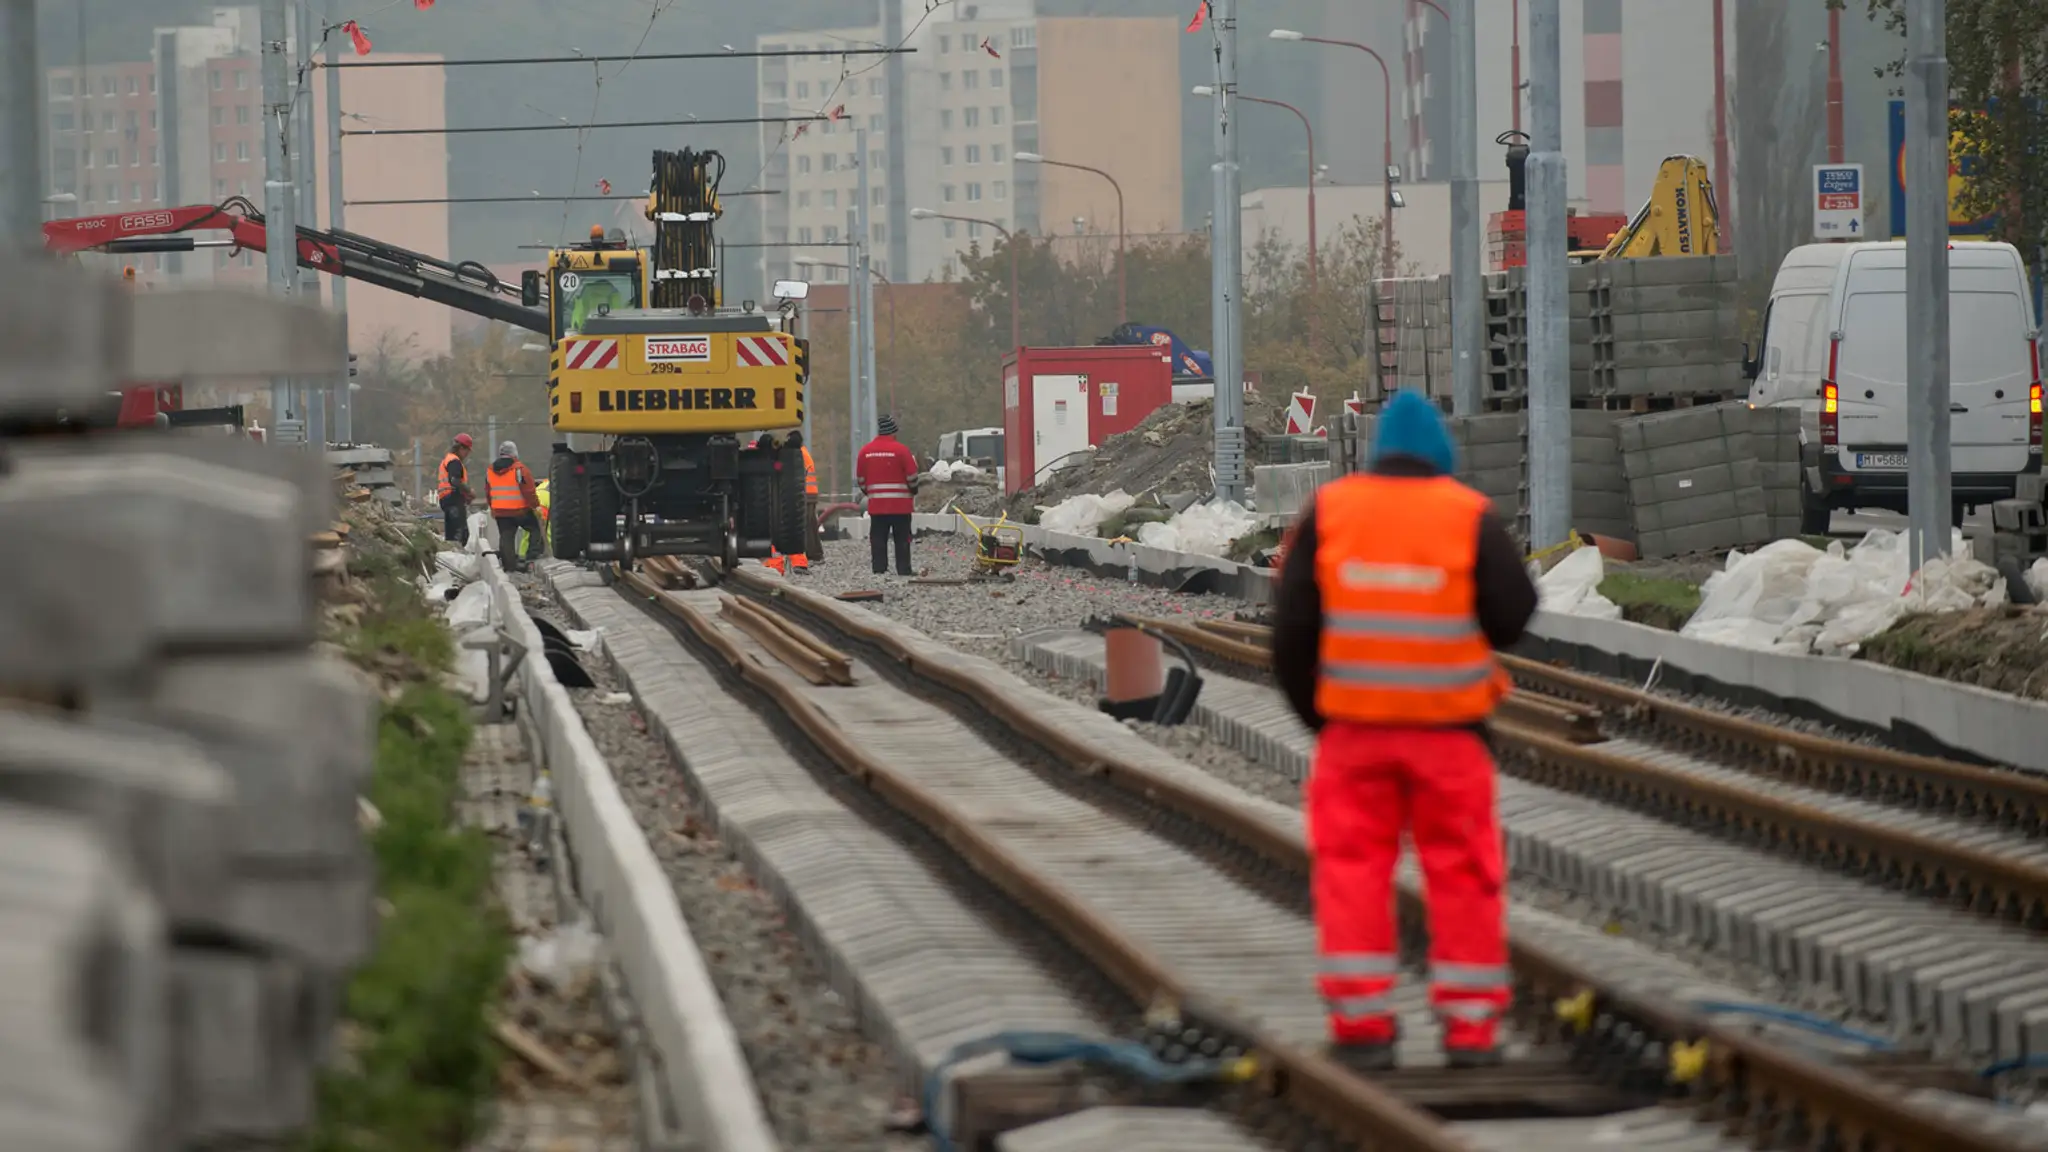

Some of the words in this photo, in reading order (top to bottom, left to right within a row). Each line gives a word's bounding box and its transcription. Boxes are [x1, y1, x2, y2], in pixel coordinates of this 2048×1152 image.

[124, 214, 171, 229] FASSI
[1675, 187, 1691, 254] KOMATSU
[563, 275, 577, 288] 20
[648, 343, 707, 355] STRABAG
[651, 362, 674, 374] 299
[599, 387, 757, 411] LIEBHERR
